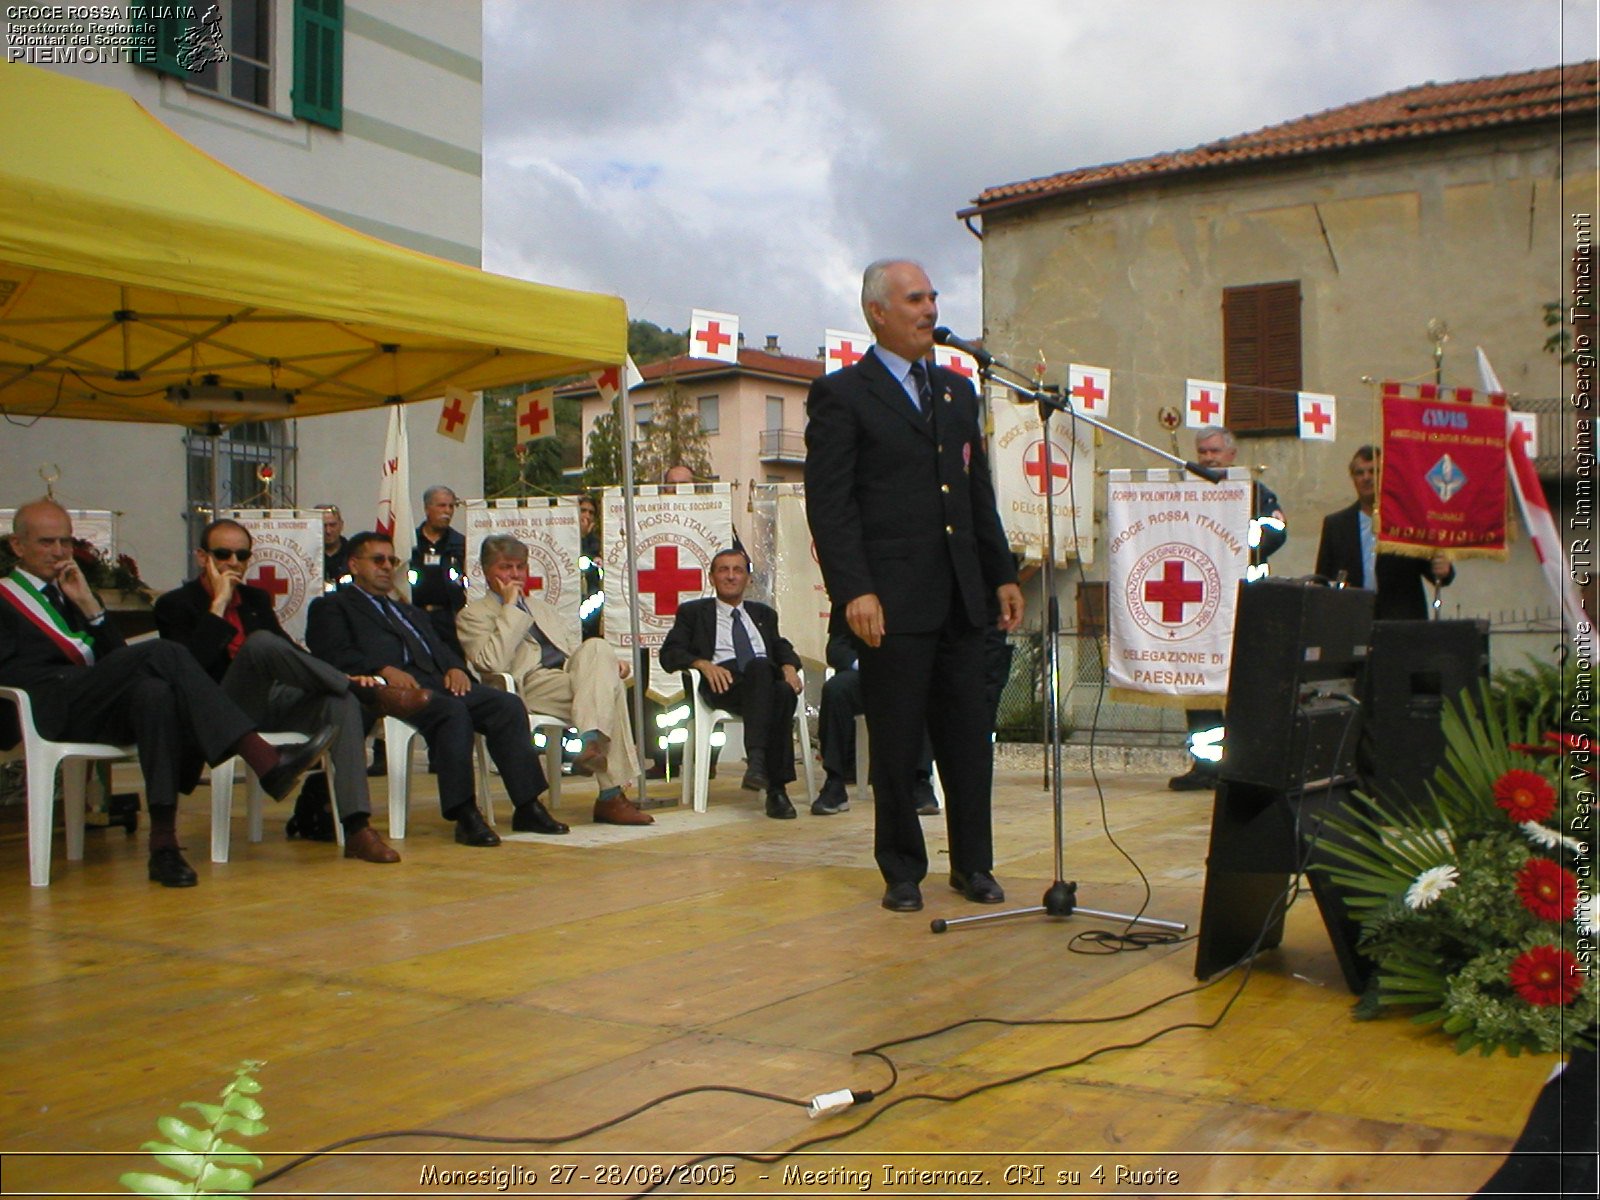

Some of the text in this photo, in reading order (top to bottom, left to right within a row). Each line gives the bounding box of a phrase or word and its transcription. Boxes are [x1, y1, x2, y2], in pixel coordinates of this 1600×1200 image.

[1140, 490, 1181, 502] VOLONTARI
[1184, 490, 1199, 502] DEL
[1202, 489, 1245, 502] SOCCORSO
[637, 511, 681, 532] ROSSA
[683, 516, 722, 554] ITALIAN
[1148, 510, 1190, 526] ROSSA
[1195, 514, 1243, 556] ITALIANA
[1128, 560, 1150, 626] CONVENZIONE
[1156, 545, 1196, 559] GINEVRA
[1123, 648, 1224, 665] DELEGAZIONE DI
[1134, 669, 1206, 686] PAESANA
